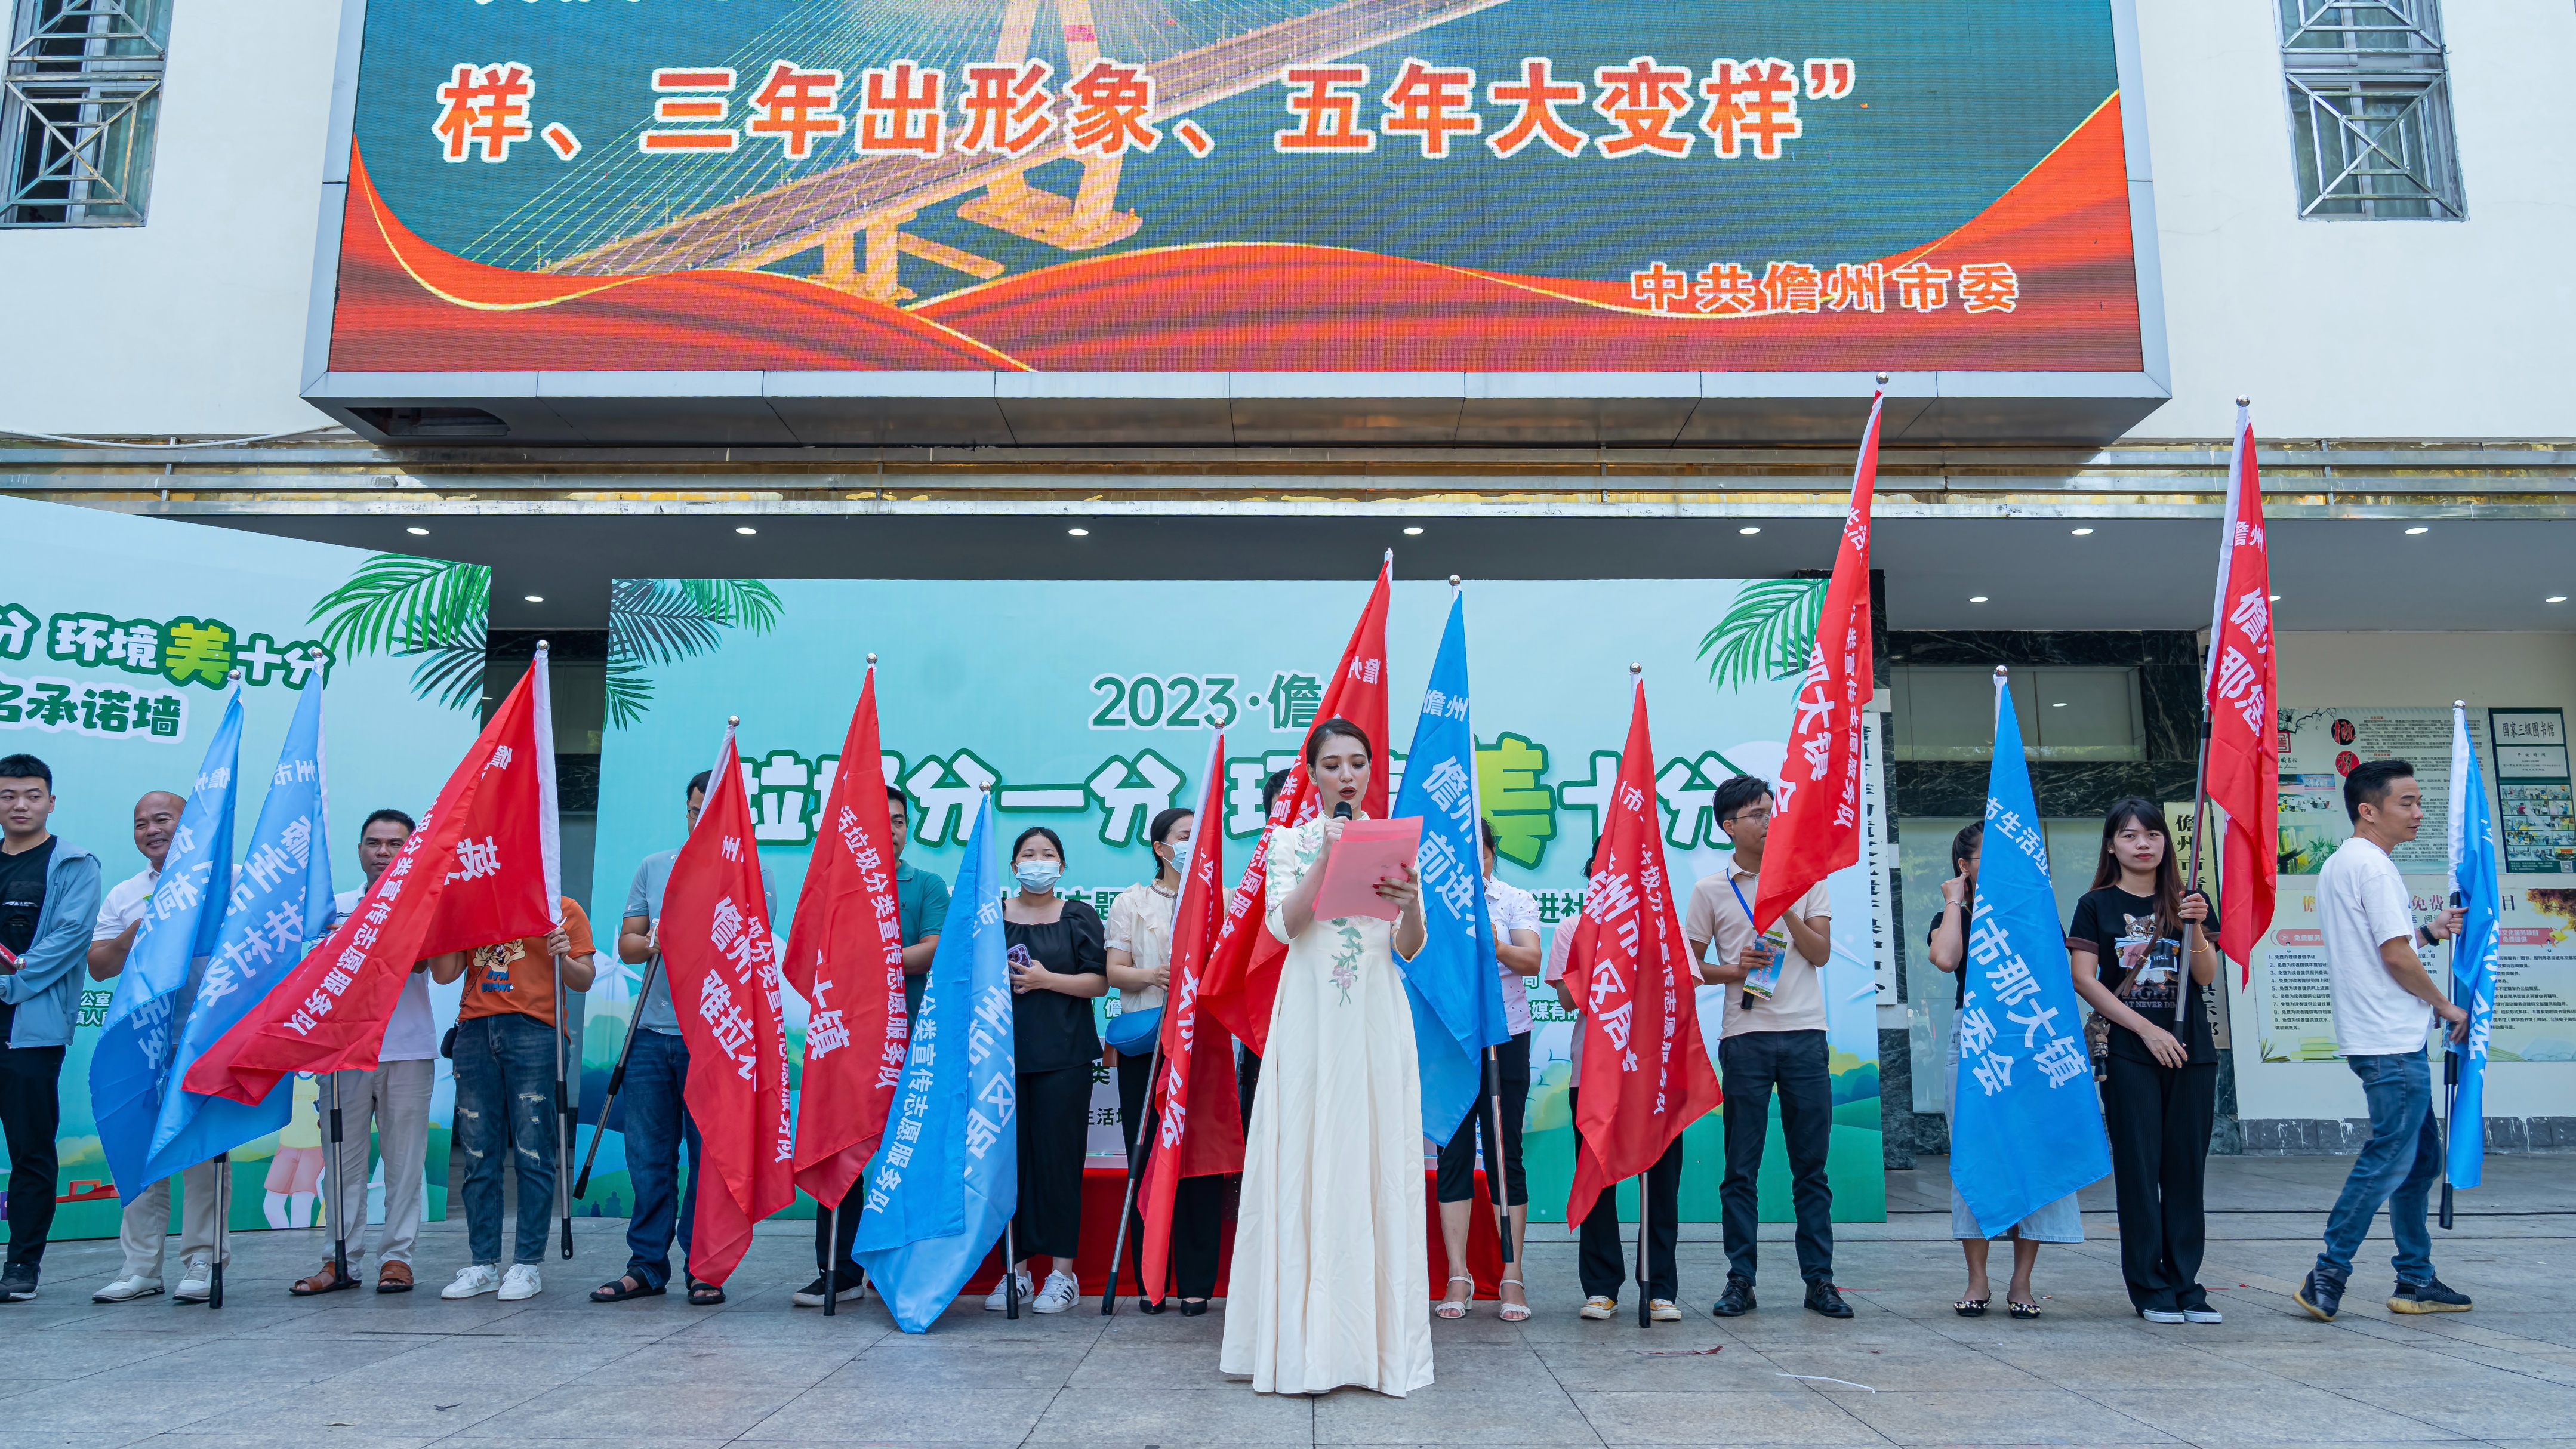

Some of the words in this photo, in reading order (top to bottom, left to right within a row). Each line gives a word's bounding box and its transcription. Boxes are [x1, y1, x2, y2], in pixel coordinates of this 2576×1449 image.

[1631, 261, 2020, 315] 中共儋州市委
[2502, 721, 2555, 738] 国家三级图书馆
